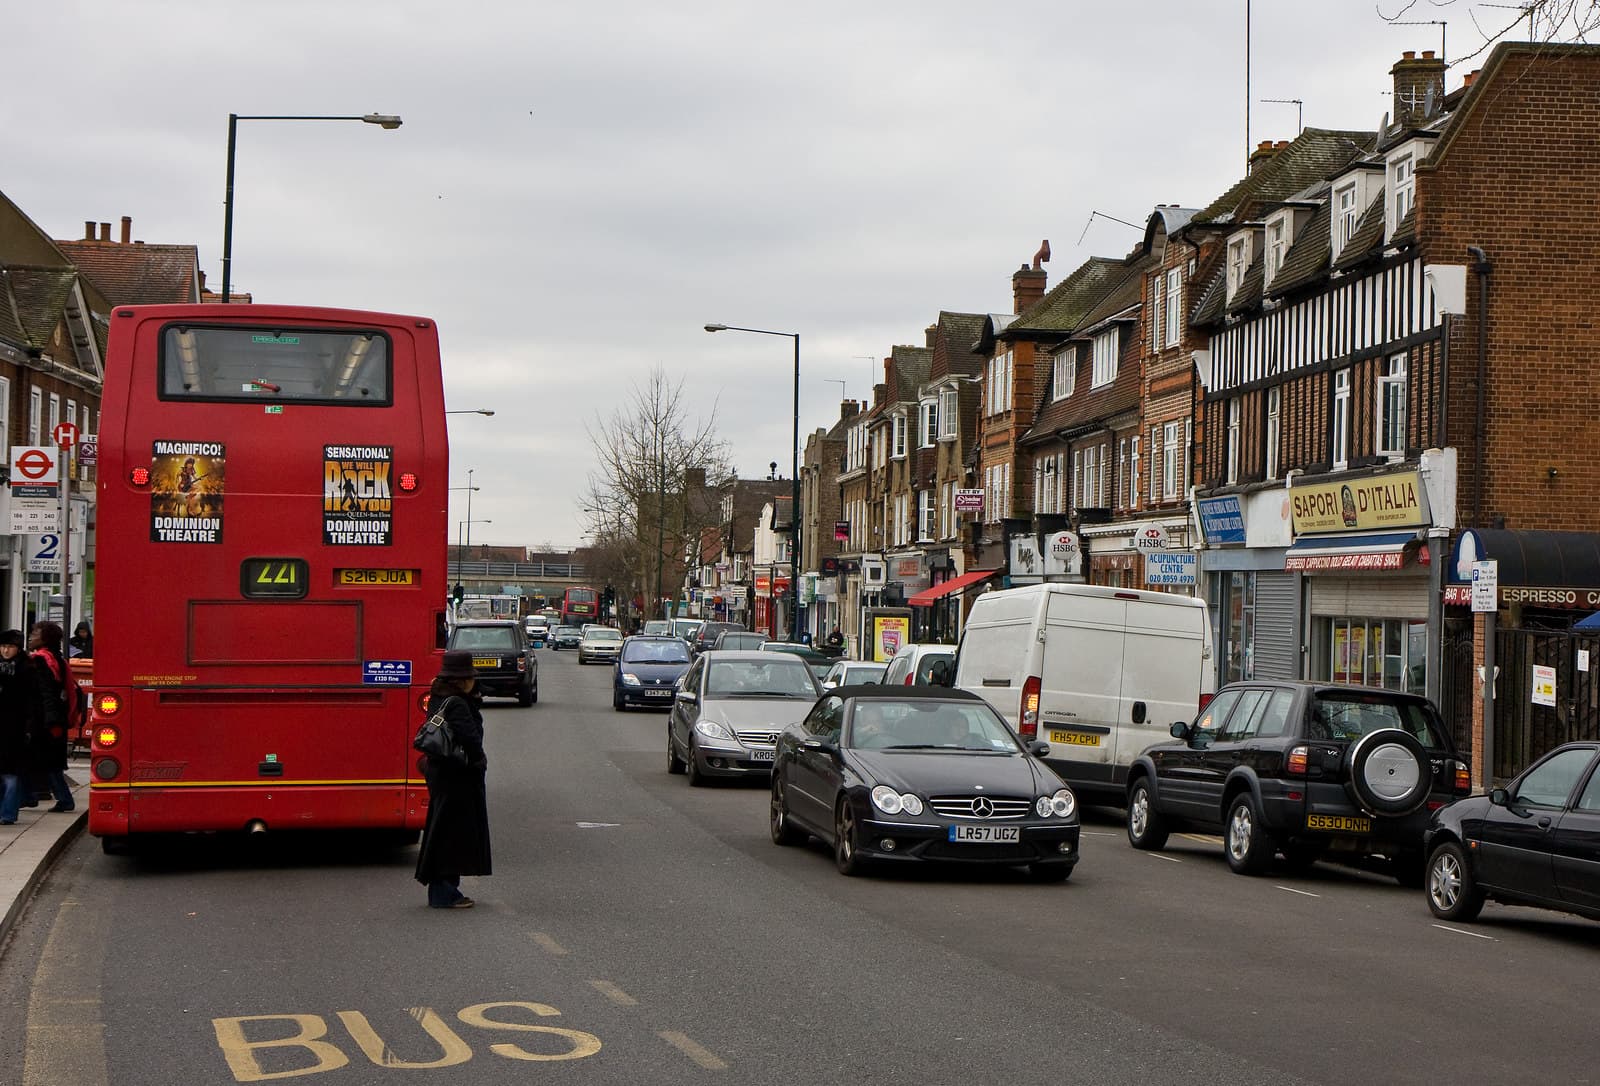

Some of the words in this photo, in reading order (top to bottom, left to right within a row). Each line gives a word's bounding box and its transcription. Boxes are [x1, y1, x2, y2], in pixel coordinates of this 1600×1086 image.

[59, 427, 74, 444] H
[342, 462, 354, 470] WE
[356, 462, 374, 470] WILL
[325, 461, 391, 510] ROCK
[358, 499, 391, 511] YOU
[1294, 491, 1338, 518] SAPORI
[1358, 482, 1418, 513] D'ITALIA
[155, 517, 220, 530] DOMINION
[326, 520, 389, 532] DOMINION
[158, 529, 216, 542] THEATRE
[330, 533, 385, 544] THEATRE
[34, 534, 58, 559] 2
[1053, 544, 1076, 552] HSBC
[1138, 538, 1166, 548] HSBC
[1150, 554, 1196, 564] ACUPUNCTURE
[1160, 564, 1184, 574] CENTRE
[345, 570, 377, 582] S216
[381, 571, 408, 582] JUA
[1150, 574, 1161, 582] 020
[1180, 576, 1194, 584] 4979
[1444, 588, 1458, 600] BAR
[1460, 588, 1473, 600] CAF
[1502, 589, 1576, 604] ESPRESSO
[1587, 591, 1600, 604] C
[1054, 732, 1077, 742] FH57
[1080, 736, 1097, 744] CPU
[1310, 816, 1342, 828] S630
[958, 827, 991, 840] LR57
[994, 828, 1018, 840] UGZ
[211, 1001, 602, 1082] BUS
